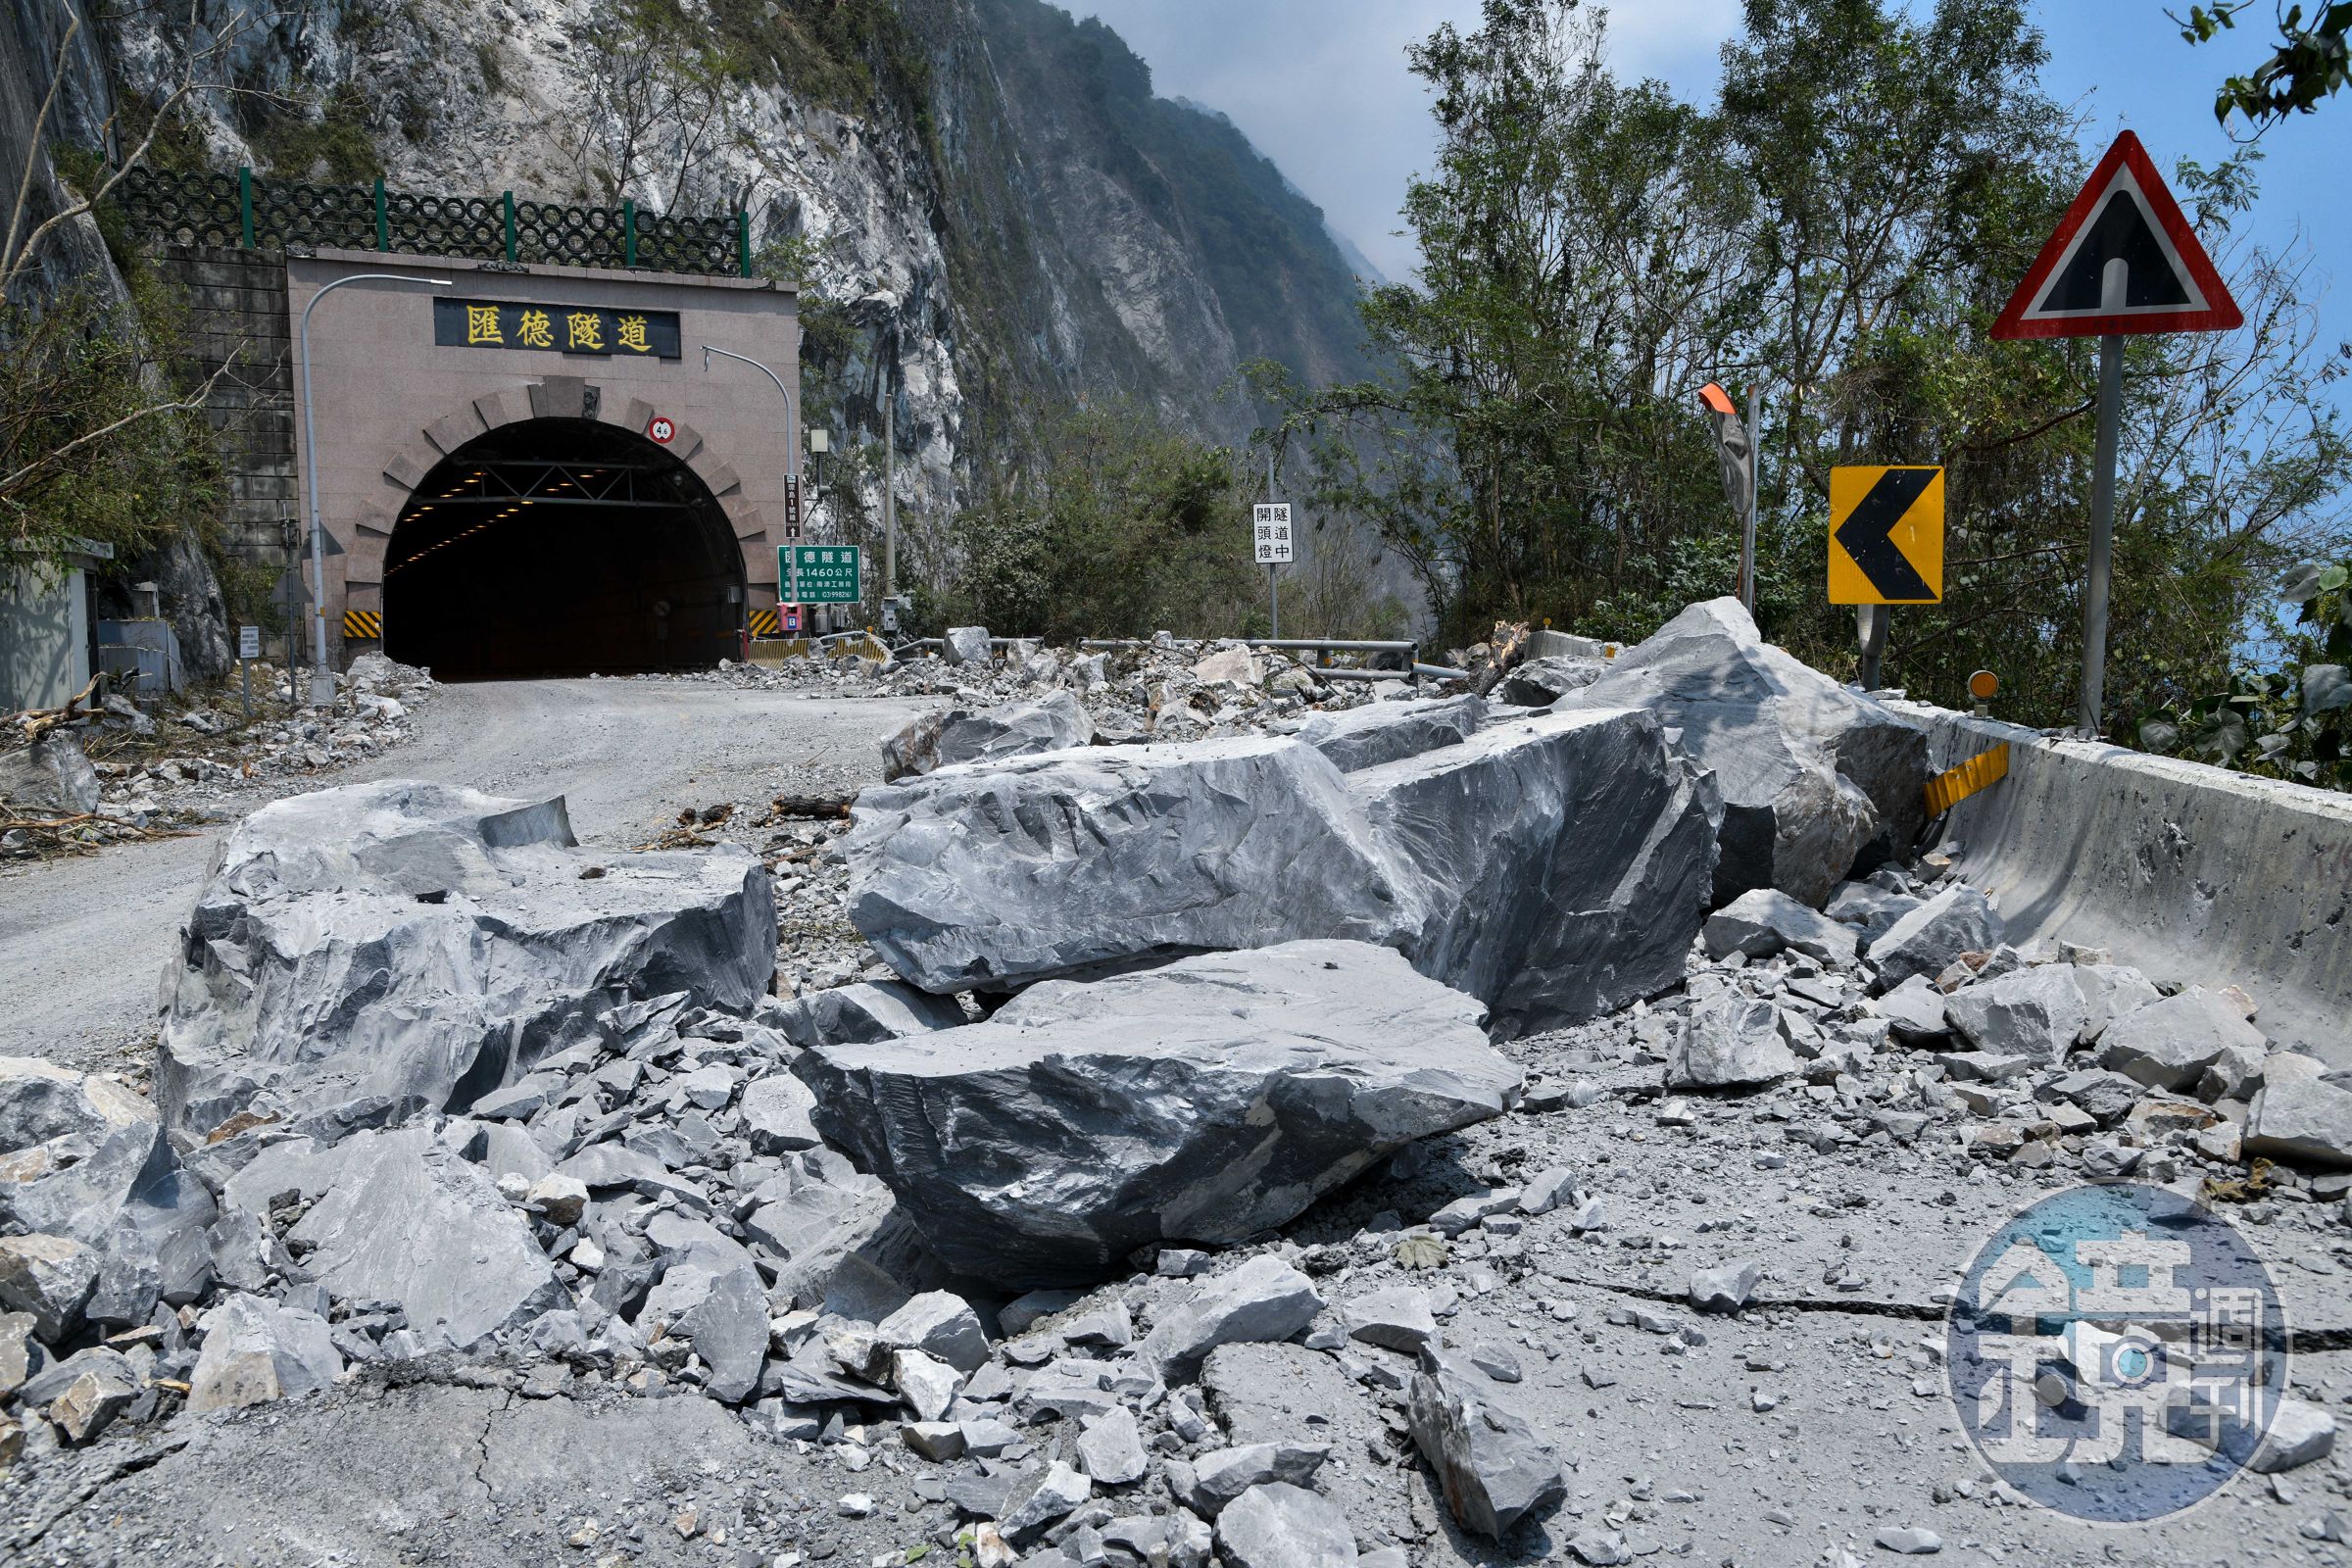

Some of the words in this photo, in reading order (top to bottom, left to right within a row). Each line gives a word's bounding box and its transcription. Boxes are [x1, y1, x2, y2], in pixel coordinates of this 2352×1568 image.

[466, 305, 653, 352] 匯德隧道
[657, 425, 668, 435] 4.6
[1256, 507, 1272, 559] 開頭燈
[1274, 507, 1290, 559] 隧道中
